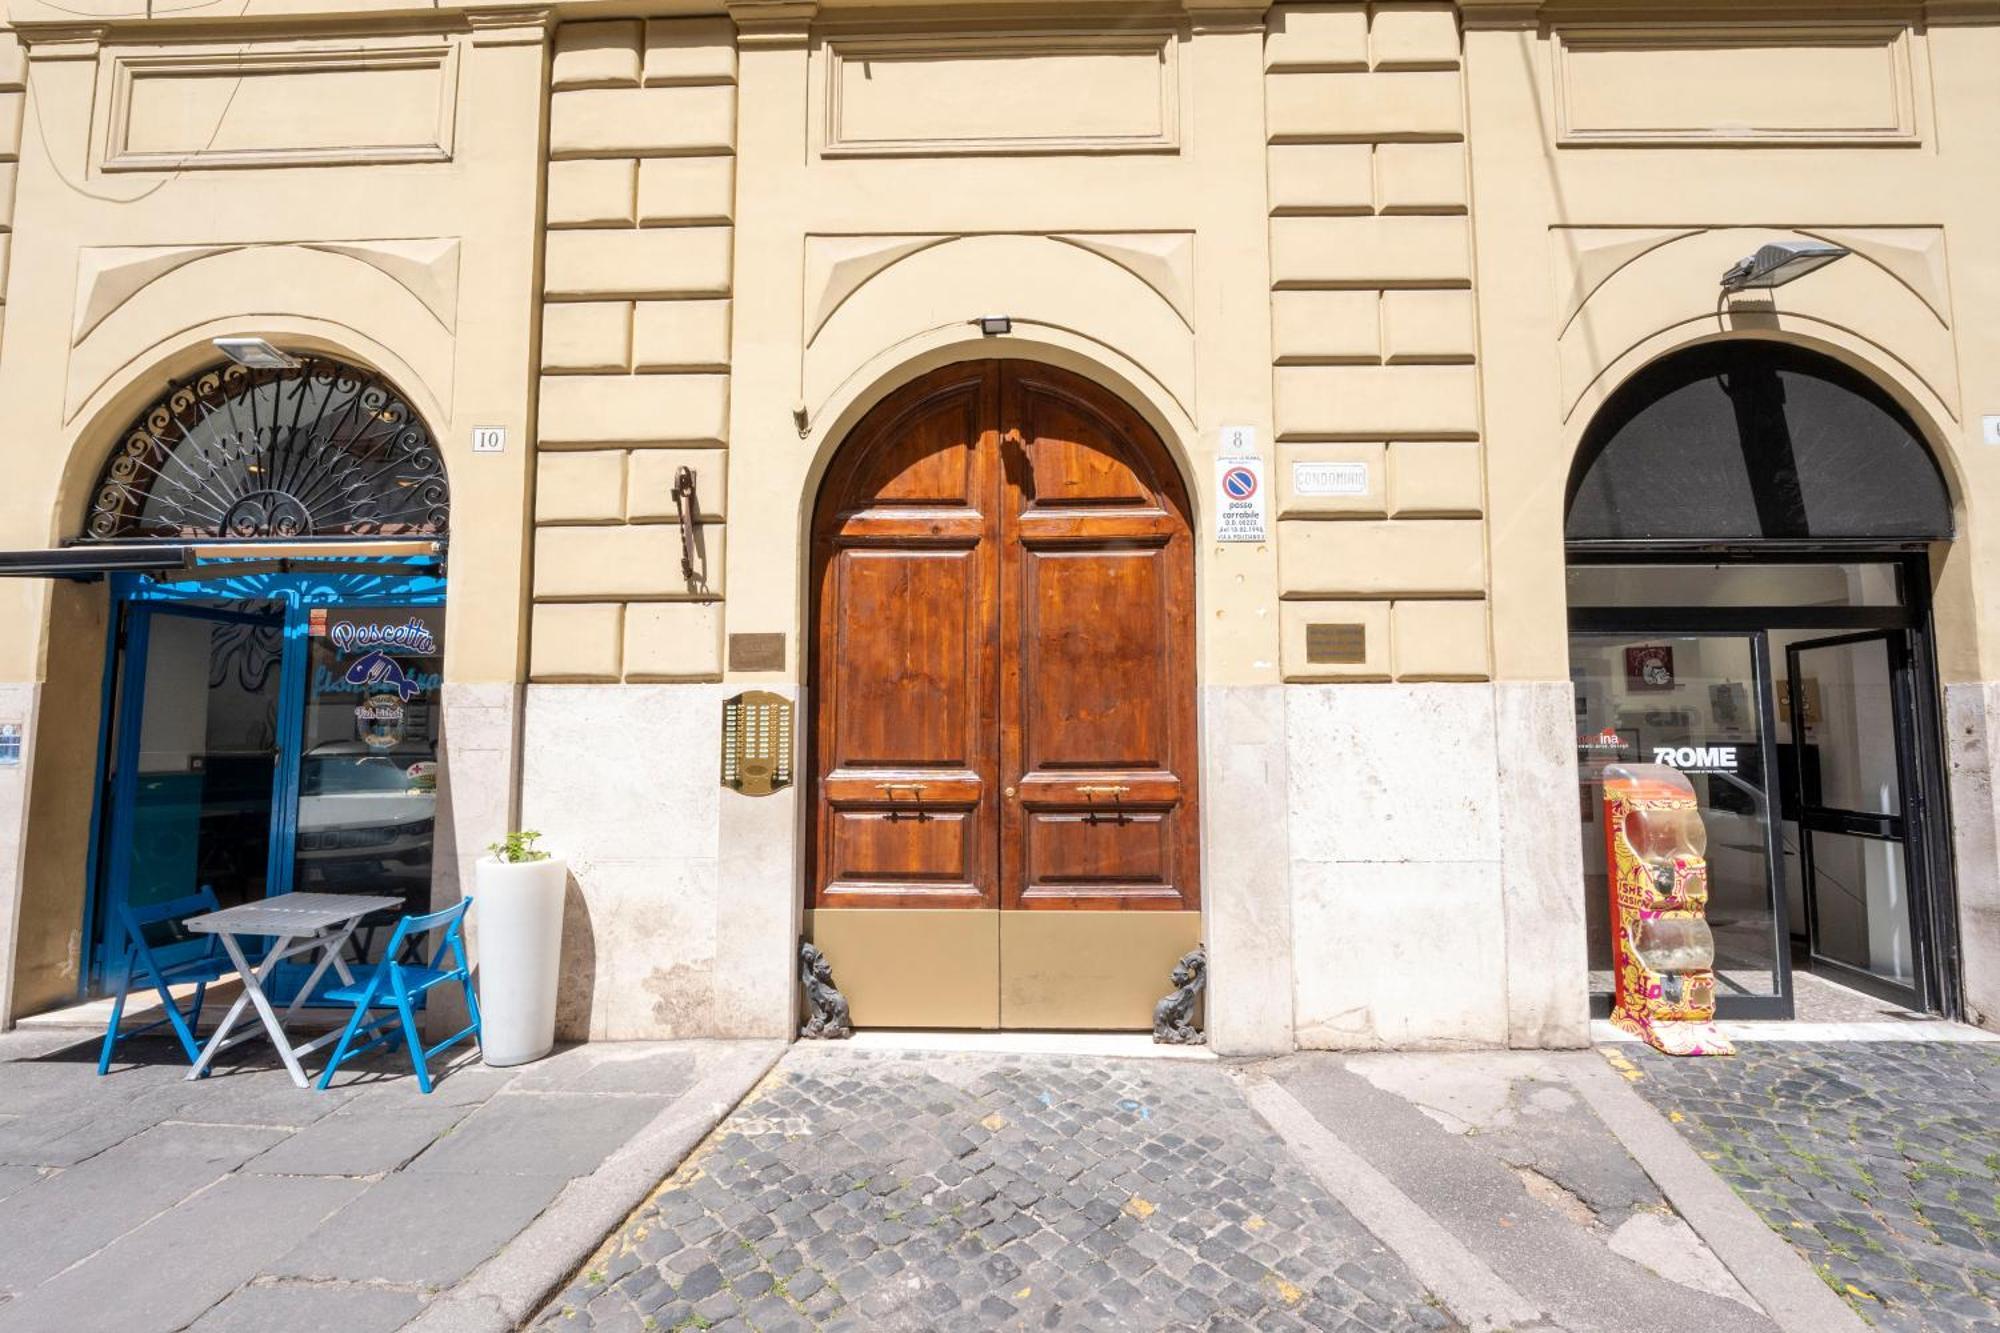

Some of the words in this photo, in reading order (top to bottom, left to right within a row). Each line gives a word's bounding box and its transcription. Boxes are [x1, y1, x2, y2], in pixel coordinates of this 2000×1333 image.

[480, 431, 499, 448] 10
[1232, 431, 1243, 448] 8
[1296, 470, 1364, 486] CONDOMINIO
[1229, 502, 1253, 510] passo
[1222, 510, 1260, 520] carrabile
